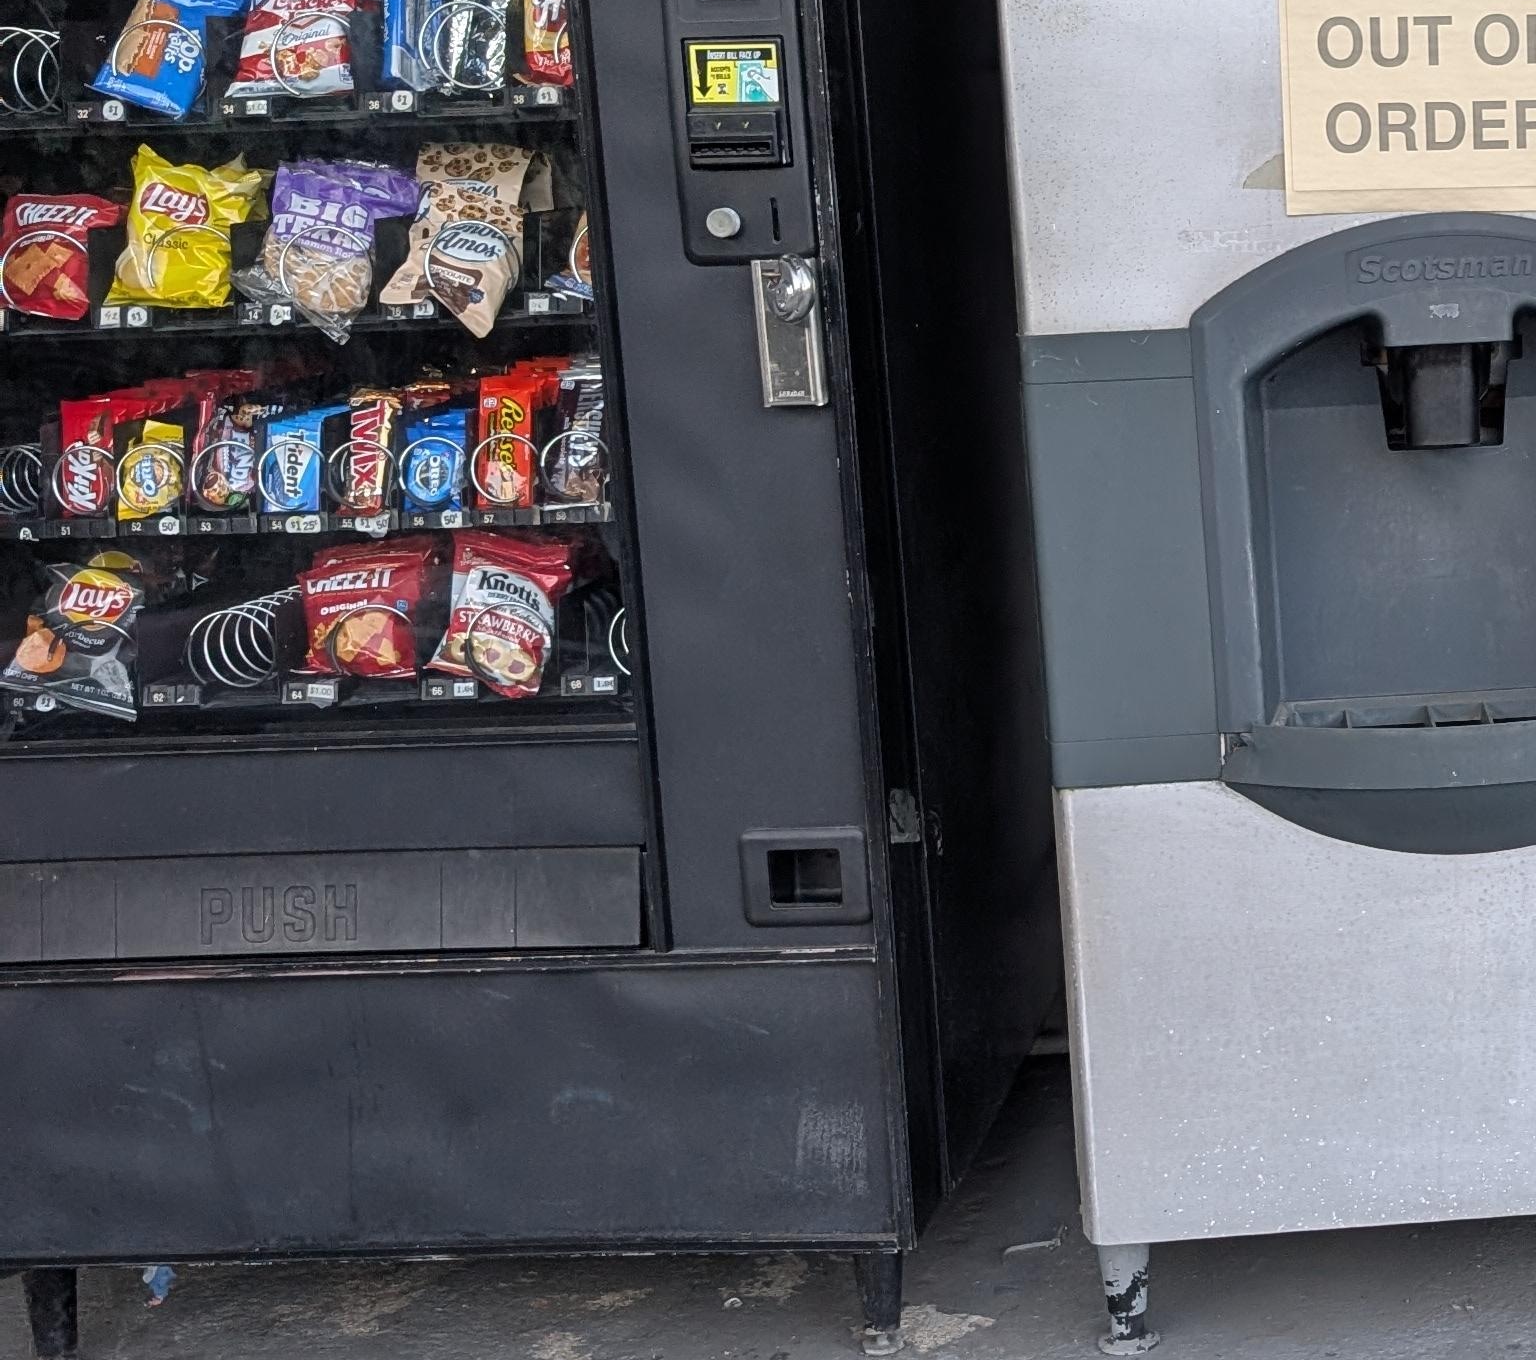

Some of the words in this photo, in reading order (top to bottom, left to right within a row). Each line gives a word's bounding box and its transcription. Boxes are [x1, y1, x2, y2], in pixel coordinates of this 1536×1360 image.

[281, 24, 330, 45] Original
[1317, 15, 1453, 69] OUT
[706, 50, 726, 60] INSERT
[753, 50, 762, 59] UP
[397, 94, 409, 106] $1
[513, 95, 525, 104] 38
[541, 91, 552, 101] $1
[77, 109, 89, 121] 32
[108, 104, 119, 116] $1
[223, 105, 234, 114] 34
[290, 192, 370, 230] BIG
[142, 233, 189, 251] Classic
[437, 231, 503, 258] Amos
[1357, 253, 1533, 285] Scotsman
[428, 454, 439, 497] OREO
[484, 513, 495, 524] 57
[61, 526, 71, 536] 51
[131, 522, 142, 532] 52
[201, 522, 212, 531] 53
[271, 521, 283, 530] 54
[477, 569, 541, 613] Knott's
[64, 630, 106, 646] arbecue
[71, 682, 83, 692] NET
[153, 693, 164, 702] 62
[292, 691, 302, 700] 64
[13, 697, 24, 707] 60
[200, 883, 358, 946] PUSH
